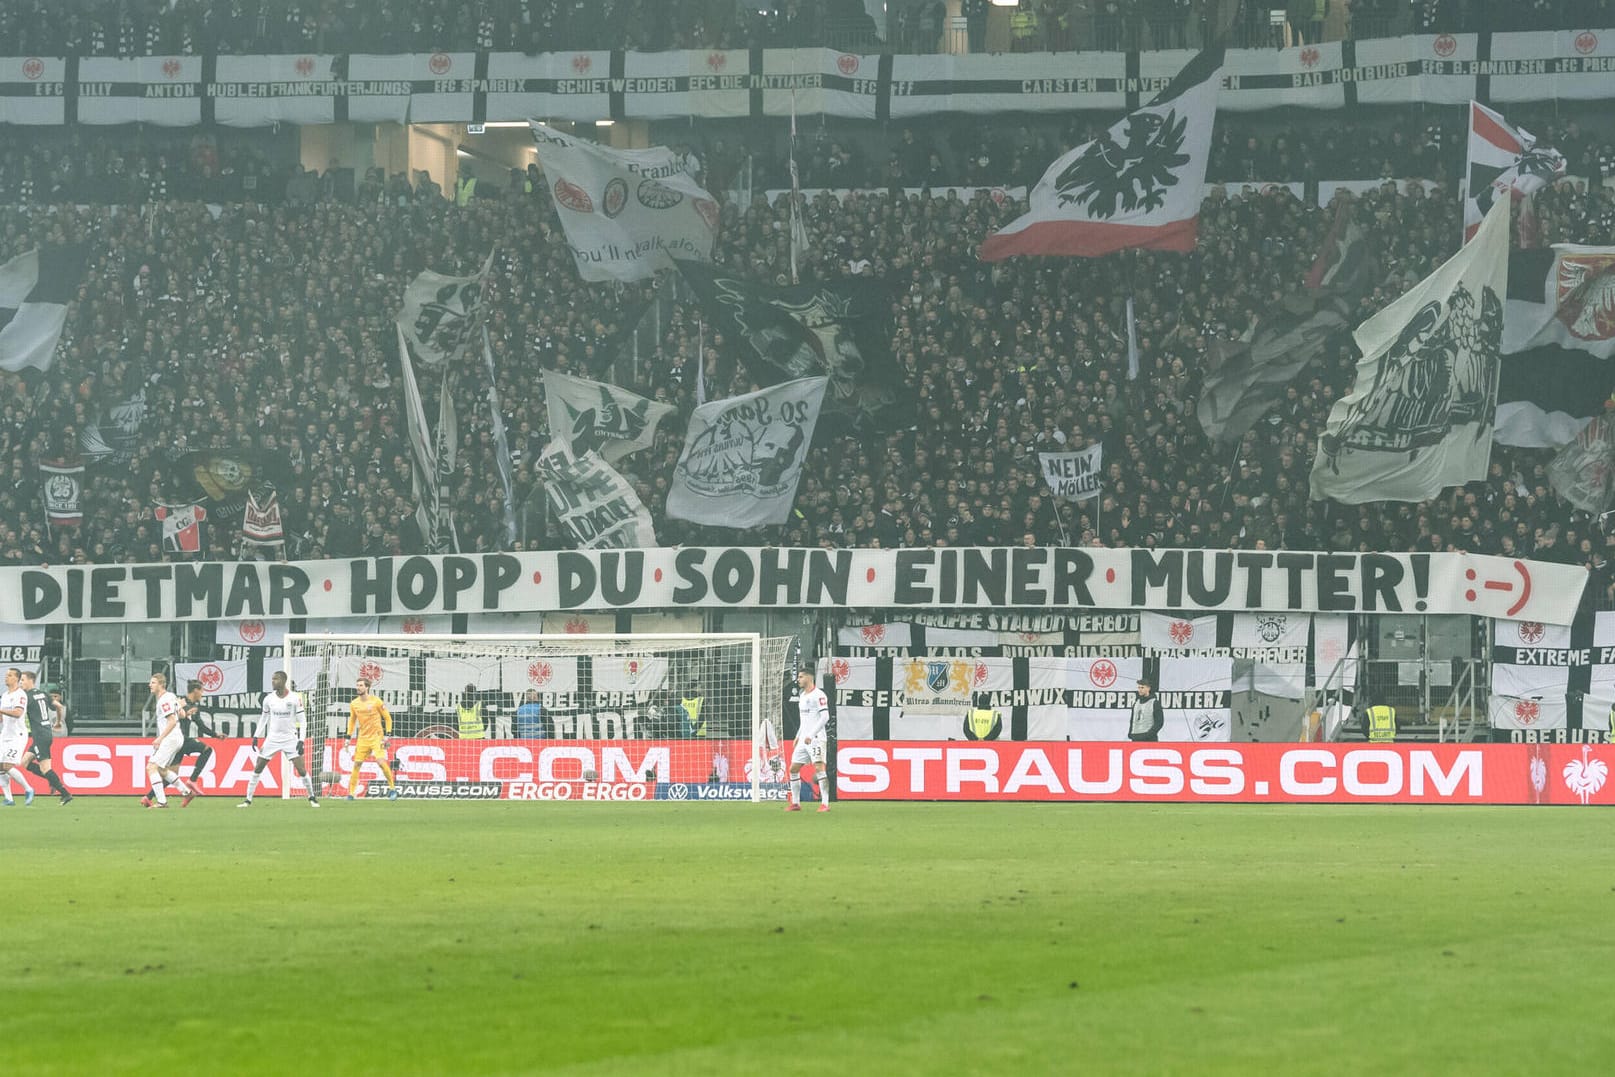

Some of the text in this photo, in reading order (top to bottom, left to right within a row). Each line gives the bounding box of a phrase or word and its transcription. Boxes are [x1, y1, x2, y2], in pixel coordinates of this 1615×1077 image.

[1293, 63, 1408, 87] BAD HOMBURG
[1421, 60, 1444, 74] EFC
[145, 83, 195, 97] ANTON
[434, 80, 456, 92] EFC
[690, 76, 716, 90] EFC
[720, 75, 743, 89] DIE
[853, 79, 876, 94] EFC
[1022, 79, 1096, 93] CARSTEN
[1048, 453, 1093, 478] NEIN
[21, 563, 311, 620] DIETMAR
[351, 554, 521, 614] HOPP
[557, 550, 645, 608] DU
[672, 548, 852, 605] SOHN
[894, 548, 1096, 606] EINER
[1131, 550, 1430, 612] MUTTER!
[223, 646, 250, 660] THE
[1515, 648, 1590, 666] EXTREME
[217, 692, 262, 710] DANK
[596, 690, 651, 708] CREW
[837, 747, 1483, 797] STRAUSS.COM
[508, 783, 647, 799] ERGO ERGO
